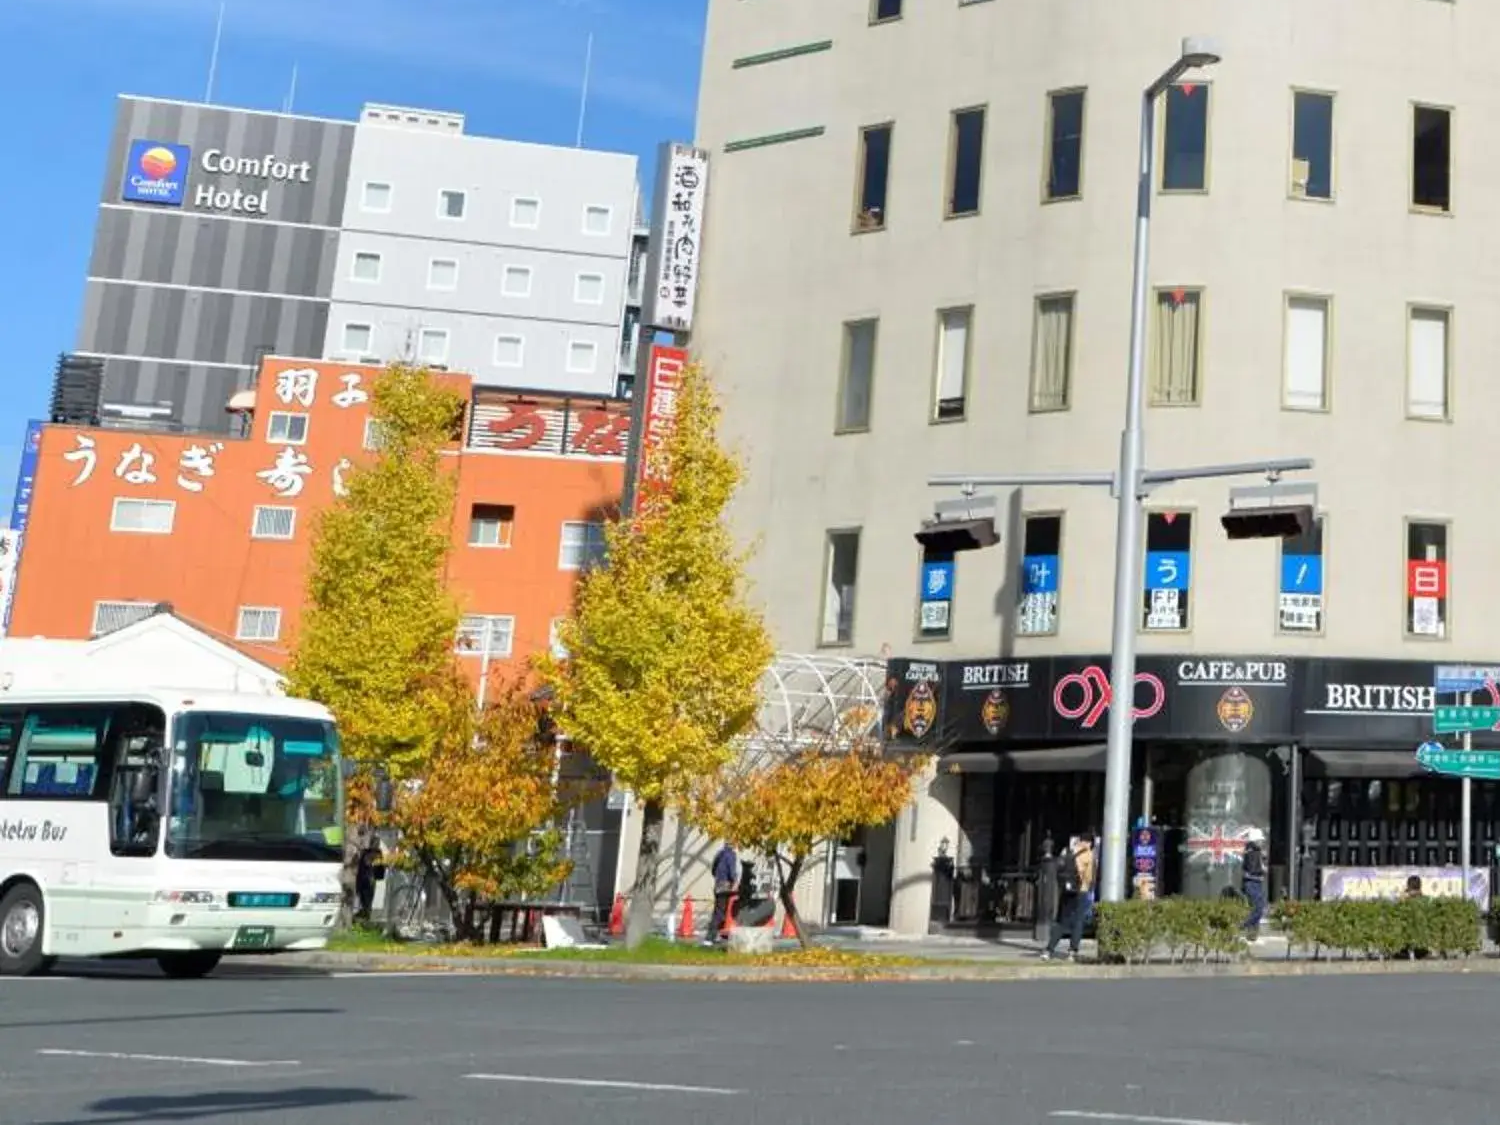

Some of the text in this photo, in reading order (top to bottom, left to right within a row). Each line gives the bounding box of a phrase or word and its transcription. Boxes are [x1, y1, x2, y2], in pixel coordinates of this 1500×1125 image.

[201, 148, 312, 182] Comfort
[194, 184, 269, 214] Hotel
[63, 434, 226, 493] うなぎ
[963, 663, 1029, 684] BRITISH
[1178, 661, 1286, 681] CAFE&PUB
[1325, 683, 1436, 711] BRITISH
